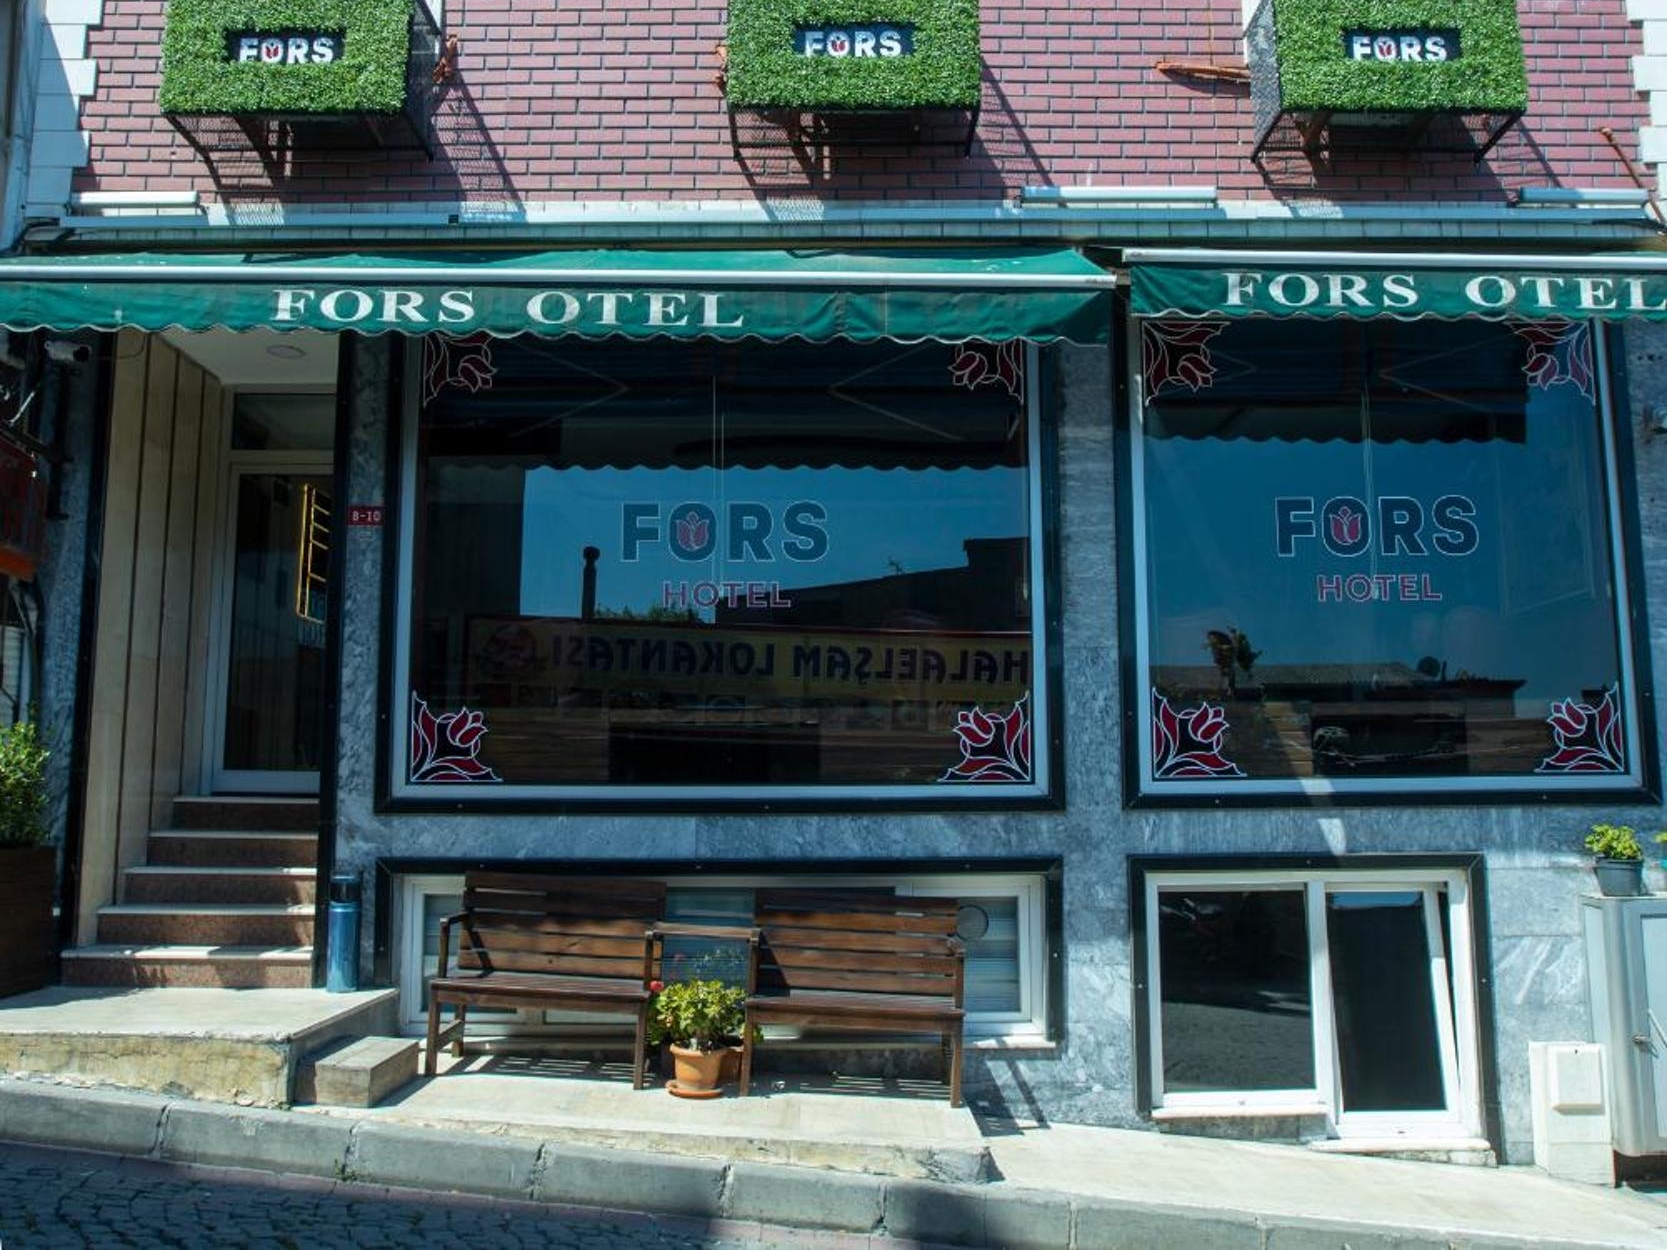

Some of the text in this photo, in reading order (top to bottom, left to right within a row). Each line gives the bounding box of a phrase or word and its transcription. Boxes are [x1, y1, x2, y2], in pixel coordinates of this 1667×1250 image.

[239, 38, 334, 64] FORS
[804, 31, 902, 58] FORS
[1352, 36, 1448, 62] FORS
[1221, 272, 1666, 310] FORS OTEL
[272, 289, 743, 327] FORS OTEL
[620, 500, 831, 563] FORS
[1274, 494, 1480, 557] FORS
[661, 580, 792, 609] HOTEL
[1316, 574, 1443, 603] HOTEL
